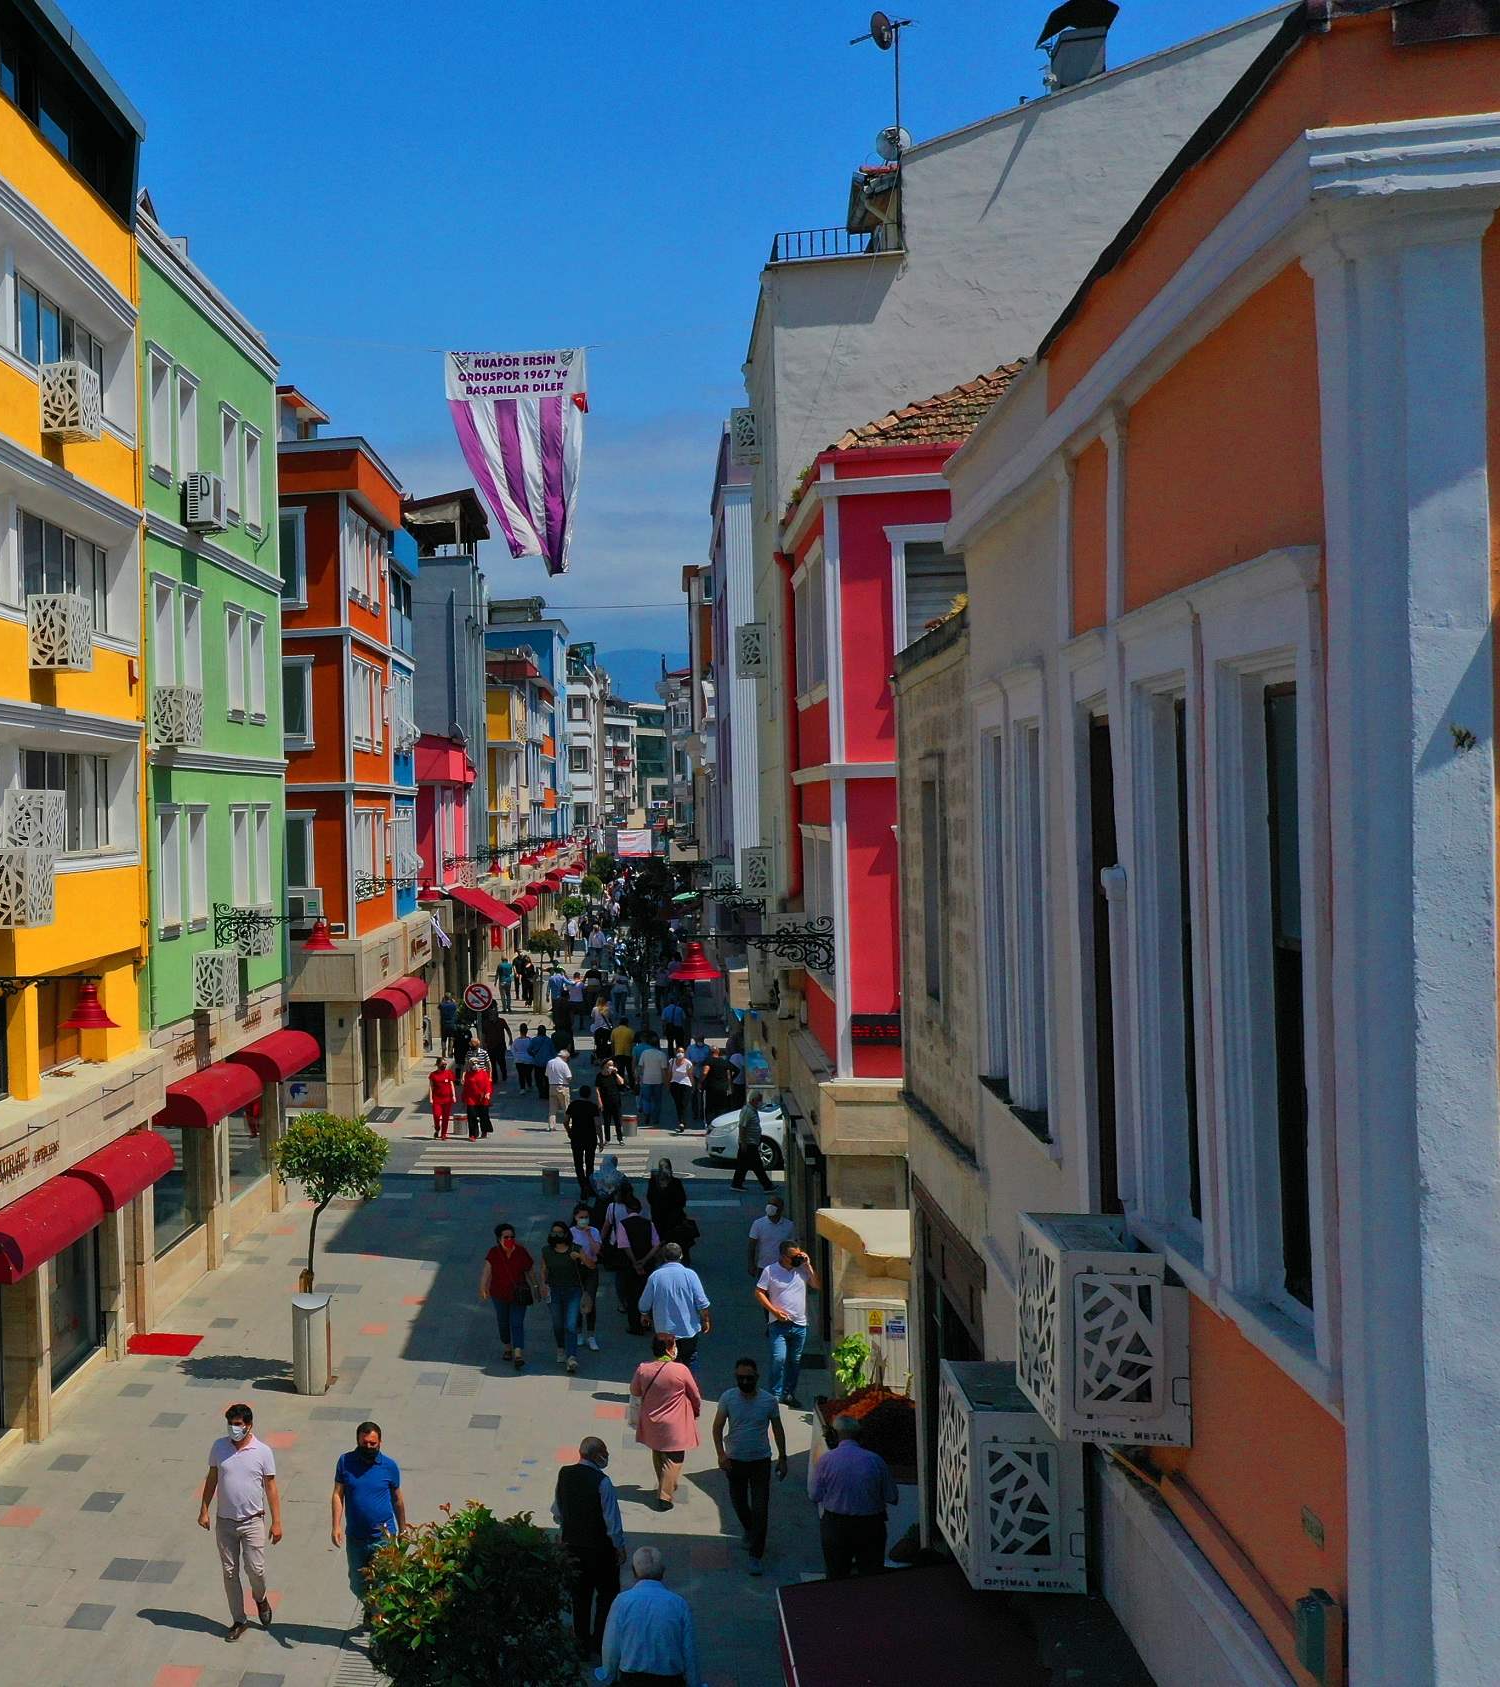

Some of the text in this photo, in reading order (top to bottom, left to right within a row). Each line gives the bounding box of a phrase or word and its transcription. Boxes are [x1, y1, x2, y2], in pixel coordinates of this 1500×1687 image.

[474, 353, 556, 368] KUAFÖR ERSİN
[458, 371, 520, 382] ORDUSPOR
[524, 370, 551, 380] 1967
[466, 381, 564, 397] BAŞARILAR DİLER
[1133, 1431, 1174, 1442] METAL
